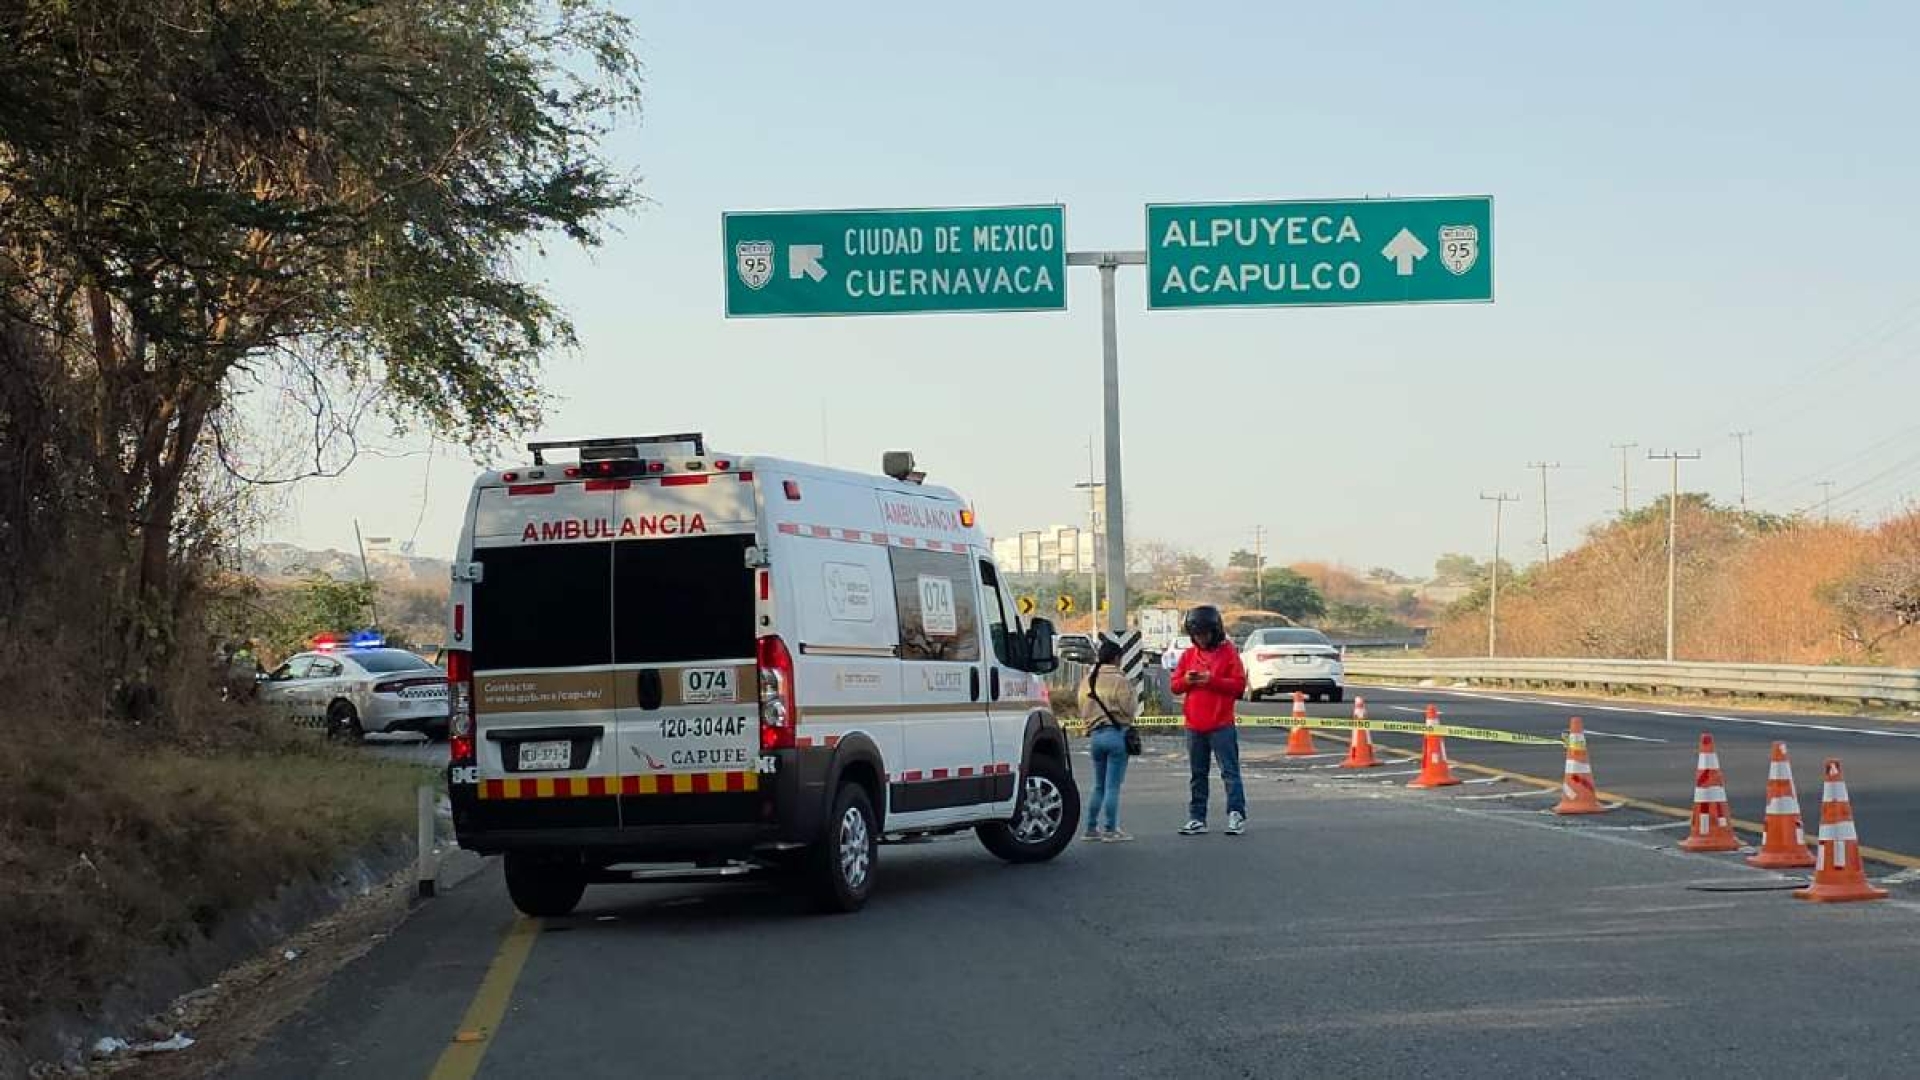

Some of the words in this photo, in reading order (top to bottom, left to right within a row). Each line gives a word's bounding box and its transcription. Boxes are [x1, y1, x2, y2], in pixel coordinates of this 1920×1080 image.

[844, 227, 923, 256] CIUDAD
[935, 226, 960, 252] DE
[973, 223, 1053, 252] MEXICO
[1162, 216, 1361, 248] ALPUYECA
[1447, 242, 1470, 258] 95
[745, 258, 767, 273] 95
[1162, 262, 1361, 294] ACAPULCO
[846, 266, 1053, 297] CUERNAVACA
[522, 513, 707, 542] AMBULANCIA
[883, 500, 960, 531] AMBULANCIA
[924, 581, 949, 612] 074
[689, 670, 727, 690] 074
[660, 716, 747, 739] 120-304AF
[671, 749, 747, 764] CAPUFE
